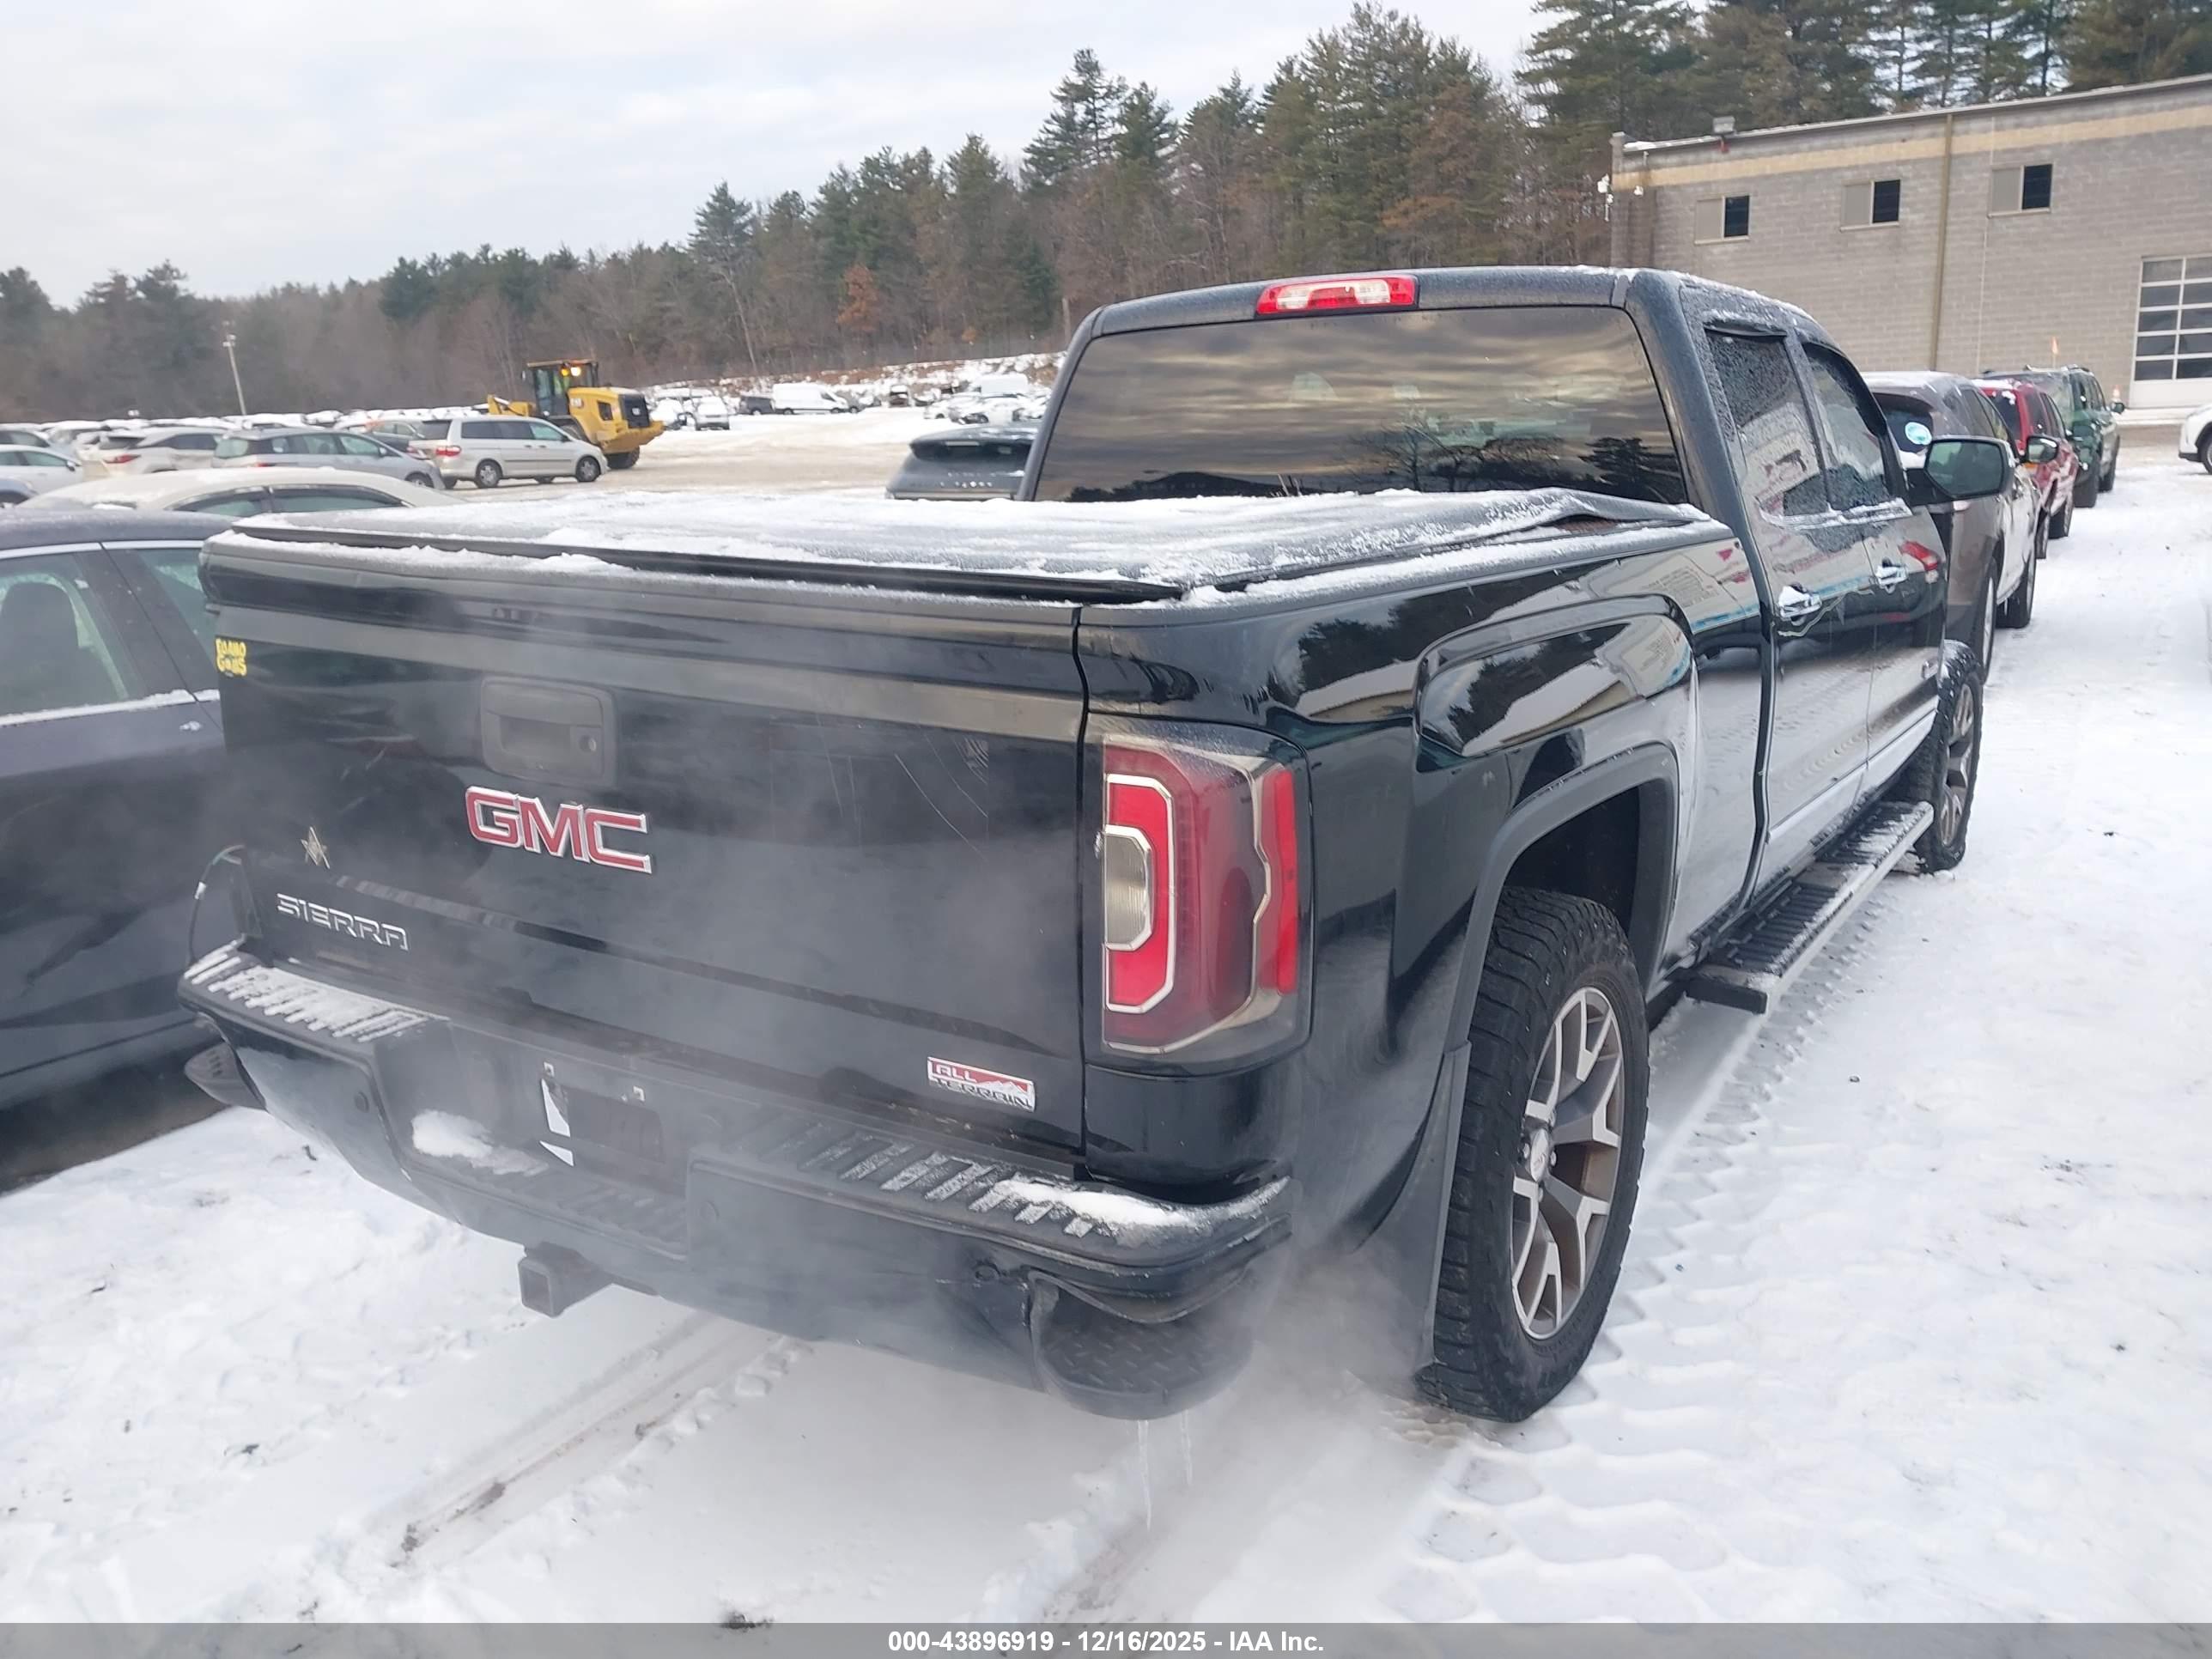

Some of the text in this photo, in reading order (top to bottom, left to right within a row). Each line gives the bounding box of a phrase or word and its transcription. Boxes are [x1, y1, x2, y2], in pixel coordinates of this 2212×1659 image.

[465, 785, 653, 874] GMC
[276, 892, 410, 951] SIERRA
[929, 1076, 1034, 1110] TERRAIN
[935, 1063, 978, 1084] ALL
